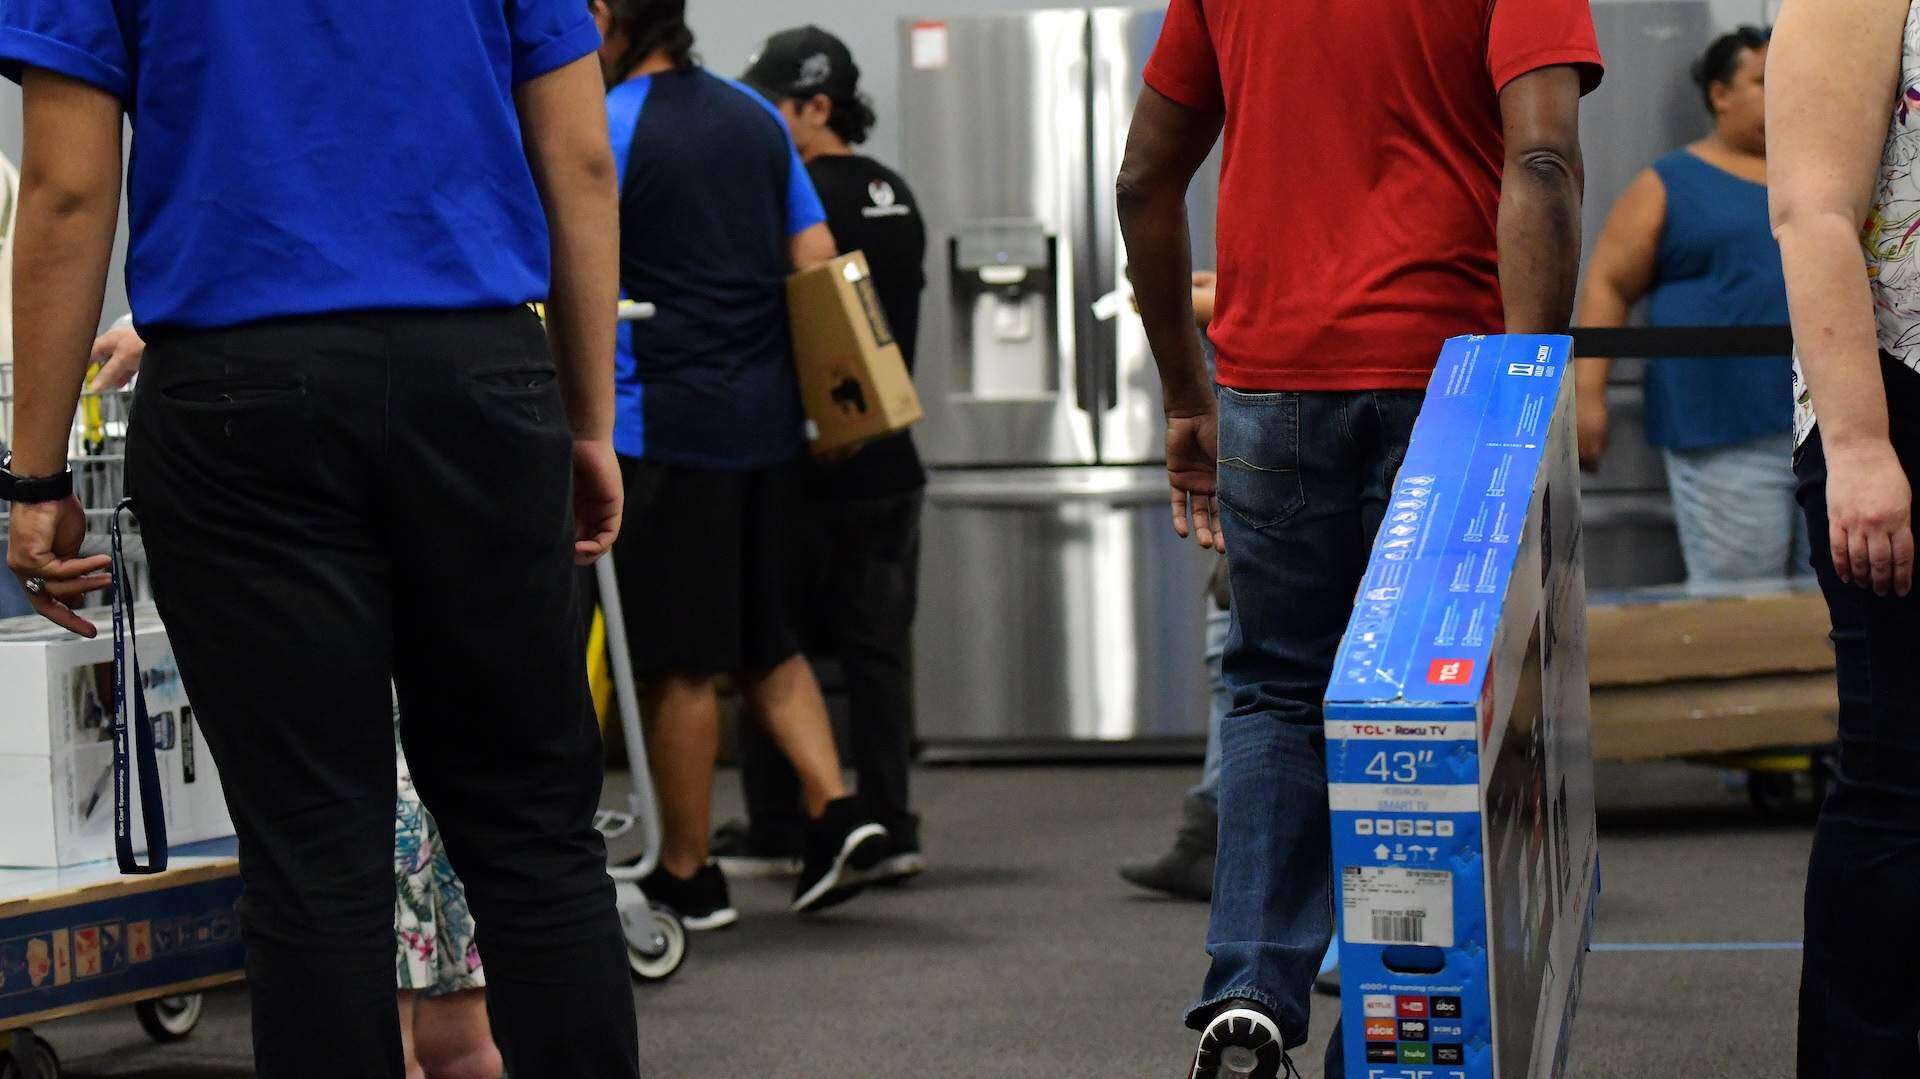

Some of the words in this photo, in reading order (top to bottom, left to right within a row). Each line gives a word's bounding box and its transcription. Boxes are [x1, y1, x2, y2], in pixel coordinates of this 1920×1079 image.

[1439, 662, 1460, 682] TCL
[1353, 725, 1384, 736] TCL
[1395, 725, 1426, 736] Roku
[1429, 725, 1447, 736] TV
[1377, 800, 1414, 811] SMART
[1416, 801, 1429, 811] TV
[1436, 1002, 1456, 1011] abc
[1367, 1024, 1394, 1035] nick
[1404, 1050, 1426, 1058] hulu
